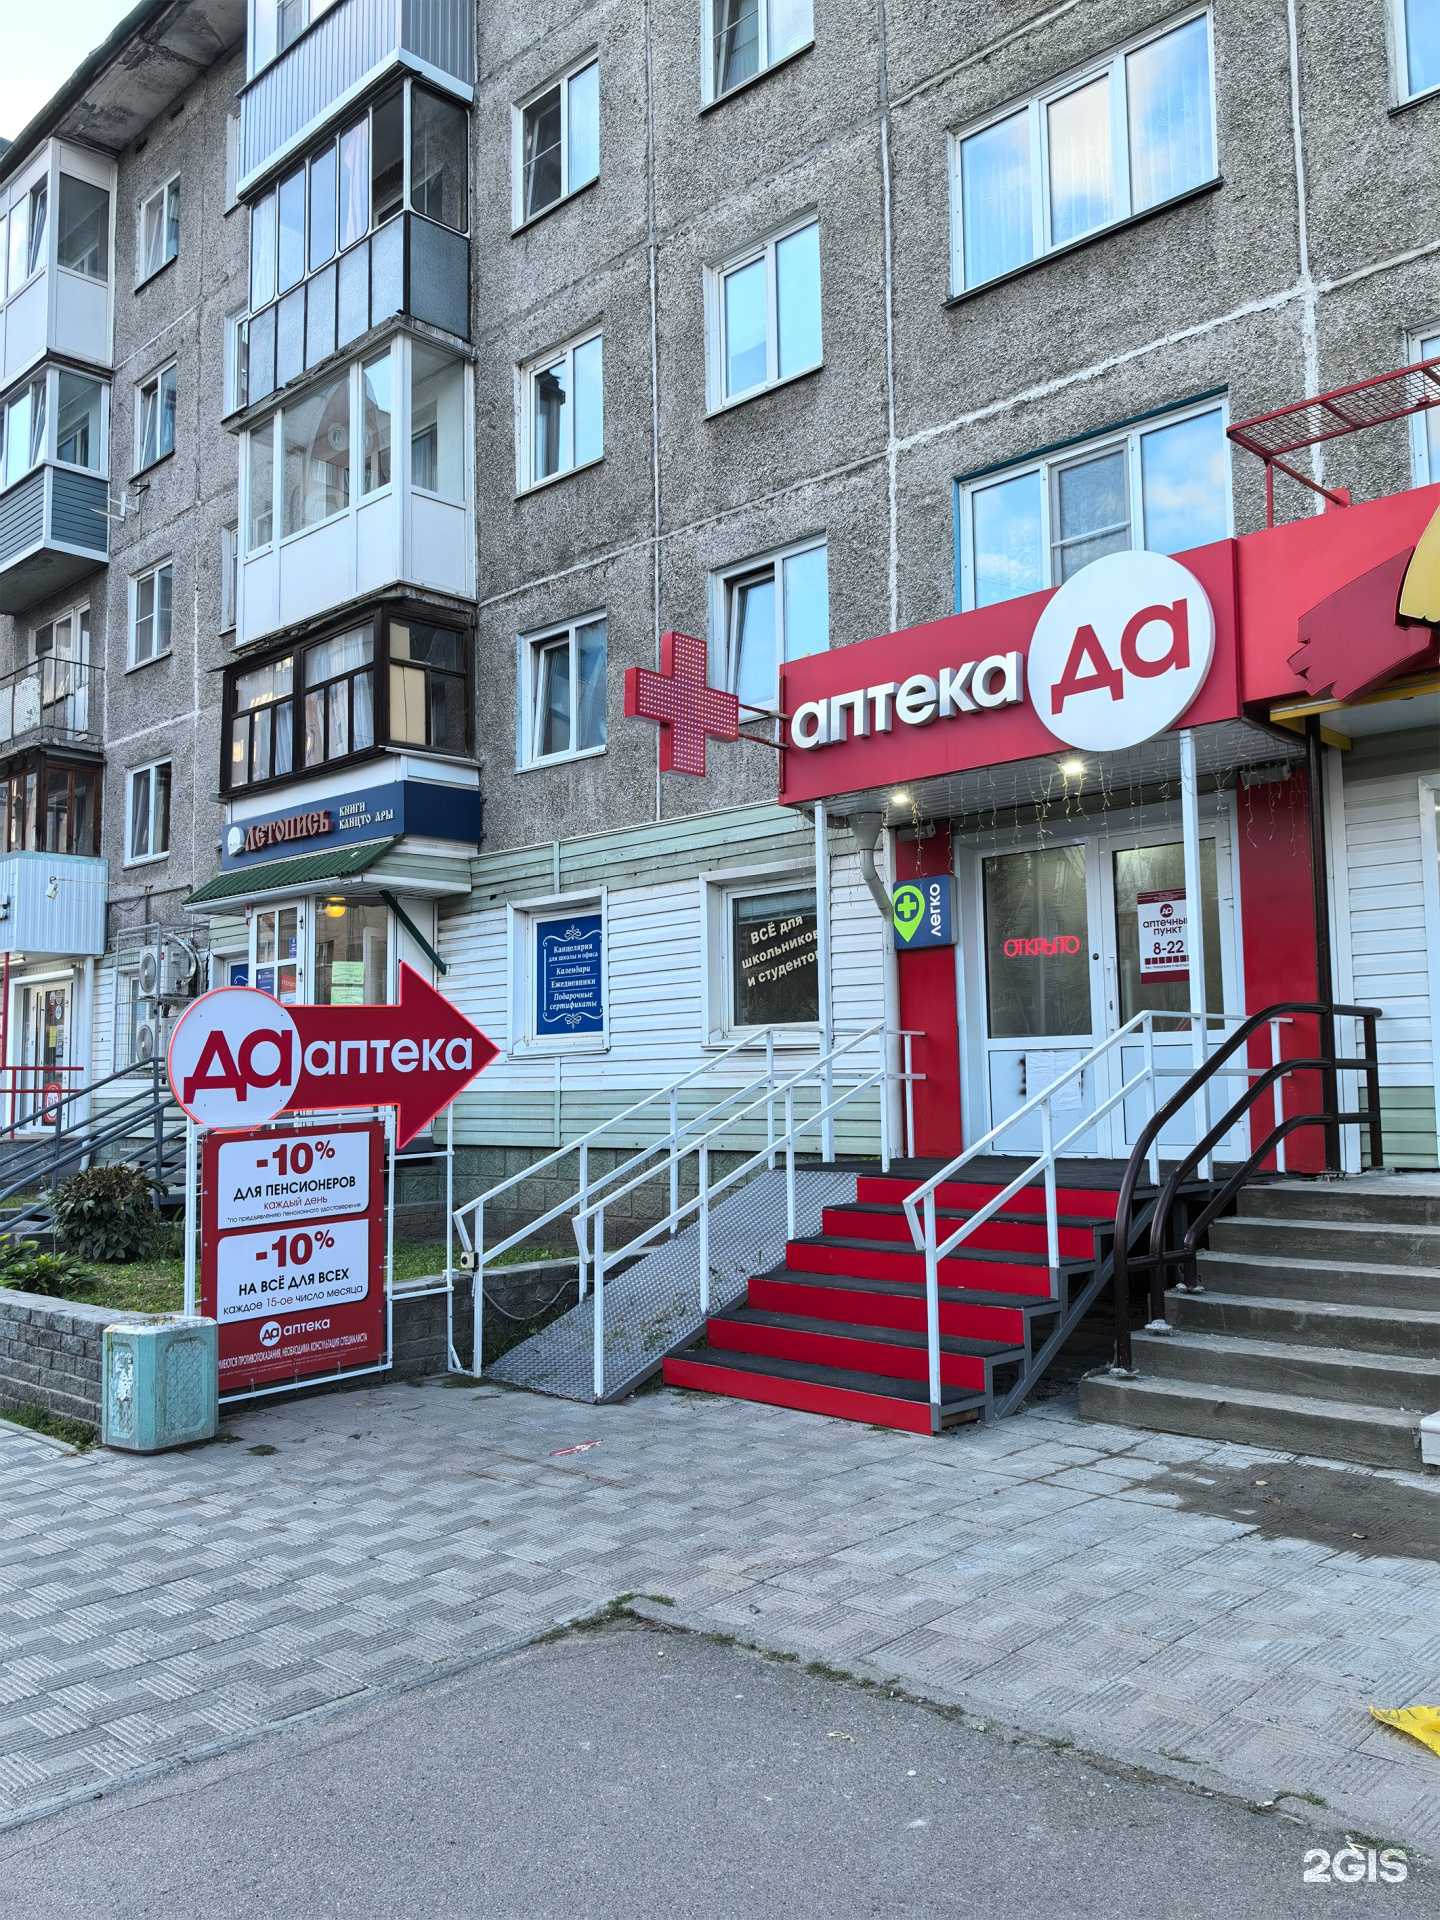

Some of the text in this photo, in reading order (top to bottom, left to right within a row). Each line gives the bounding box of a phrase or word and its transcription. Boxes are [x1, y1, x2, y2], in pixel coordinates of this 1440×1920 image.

[790, 650, 1023, 750] аптека
[339, 801, 366, 817] КНИГИ
[244, 810, 332, 851] ЛЕТОПИСЬ
[750, 915, 803, 945] ВСЁ для
[1153, 926, 1183, 937] пункт
[1003, 935, 1081, 958] ОТКРЫТО
[1153, 940, 1184, 955] 8-22
[556, 965, 591, 976] Календари
[551, 978, 596, 988] Ежедневники
[747, 976, 756, 987] и
[549, 1000, 598, 1011] сертификаты
[553, 991, 593, 1001] Подарочные
[304, 1037, 473, 1077] аптека
[256, 1140, 336, 1176] -10%
[233, 1175, 357, 1202] ДЛЯ ПЕНСИОНЕРОВ
[263, 1195, 328, 1210] каждый день
[255, 1229, 335, 1268] -10%
[238, 1267, 350, 1297] НА ВСЁ ДЛЯ ВСЕХ
[223, 1284, 363, 1316] каждое 15-ое число месяца
[283, 1318, 331, 1337] аптека
